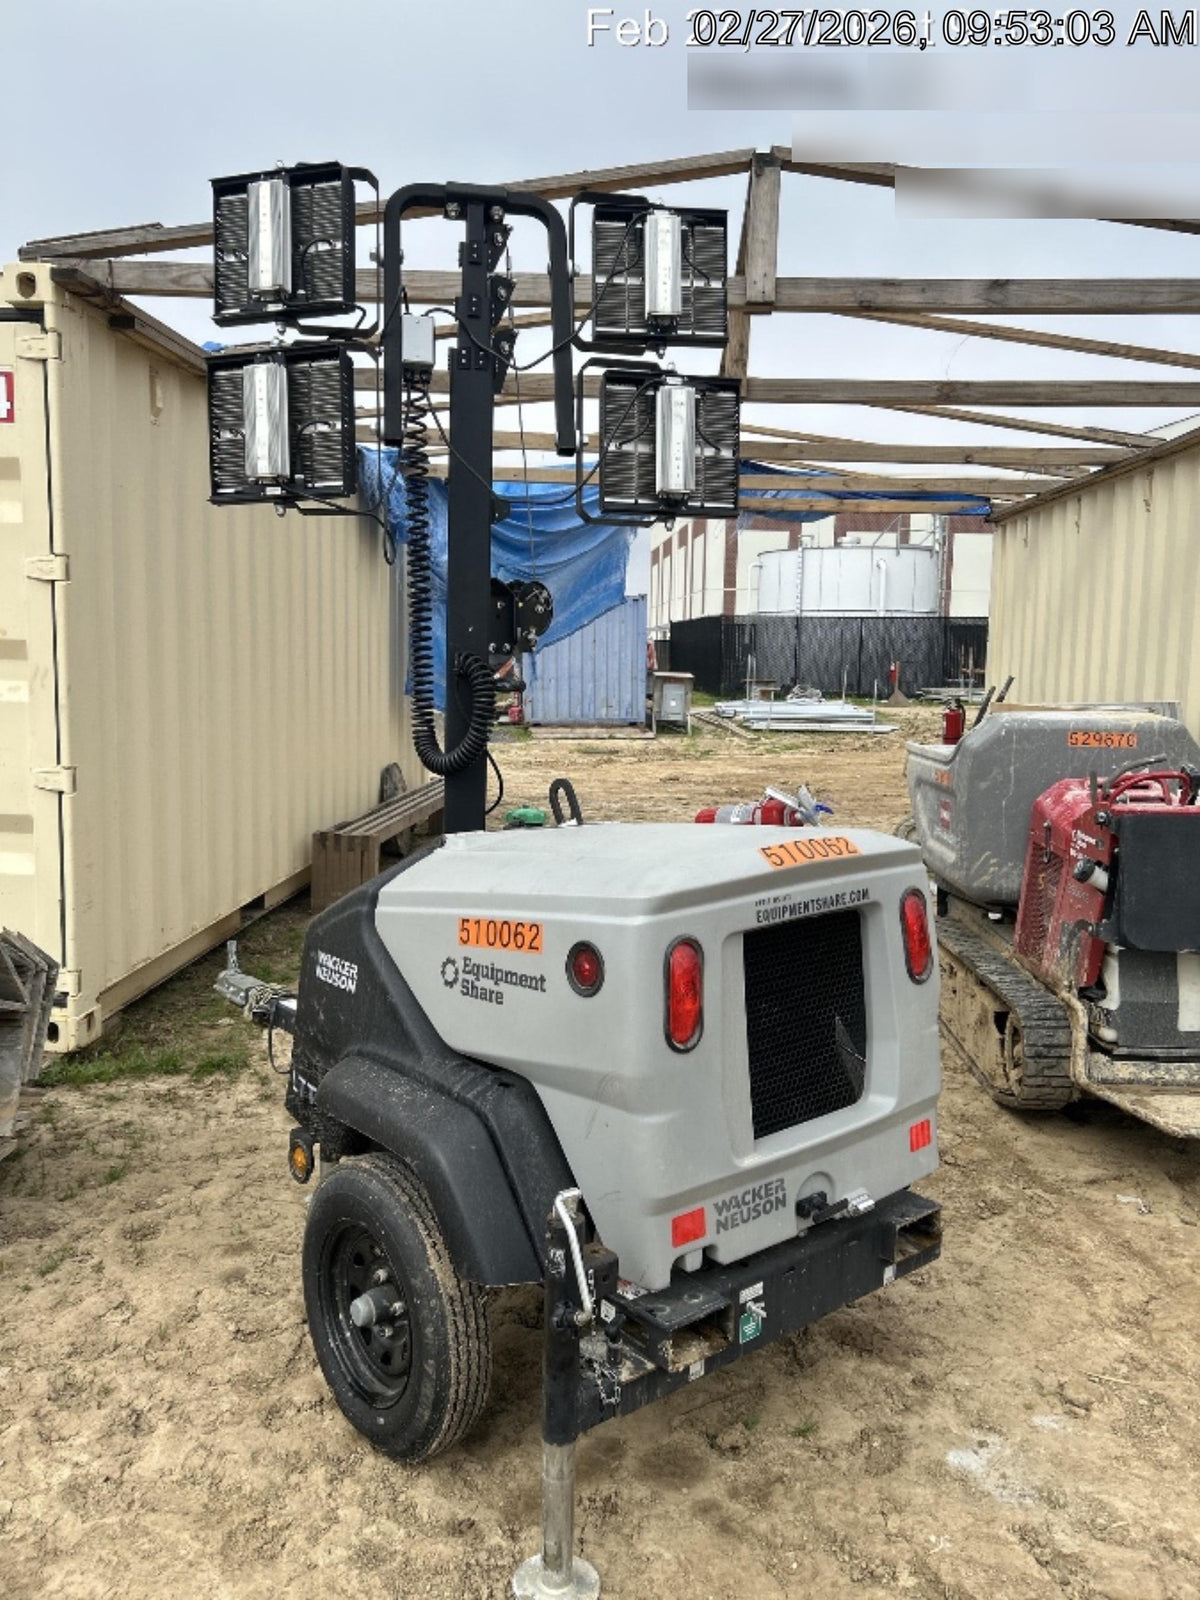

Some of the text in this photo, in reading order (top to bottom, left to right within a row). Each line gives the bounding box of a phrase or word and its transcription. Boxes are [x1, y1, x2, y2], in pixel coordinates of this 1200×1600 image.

[760, 836, 859, 867] 510062
[756, 887, 870, 924] EQUIPMENTSHARE.COM
[459, 918, 541, 951] 510062
[315, 965, 357, 994] NEUSON
[317, 949, 359, 980] WACKER
[461, 955, 547, 993] Equipment
[459, 978, 504, 1006] Share
[712, 1178, 787, 1217] WACKER
[716, 1192, 787, 1235] NEUSON
